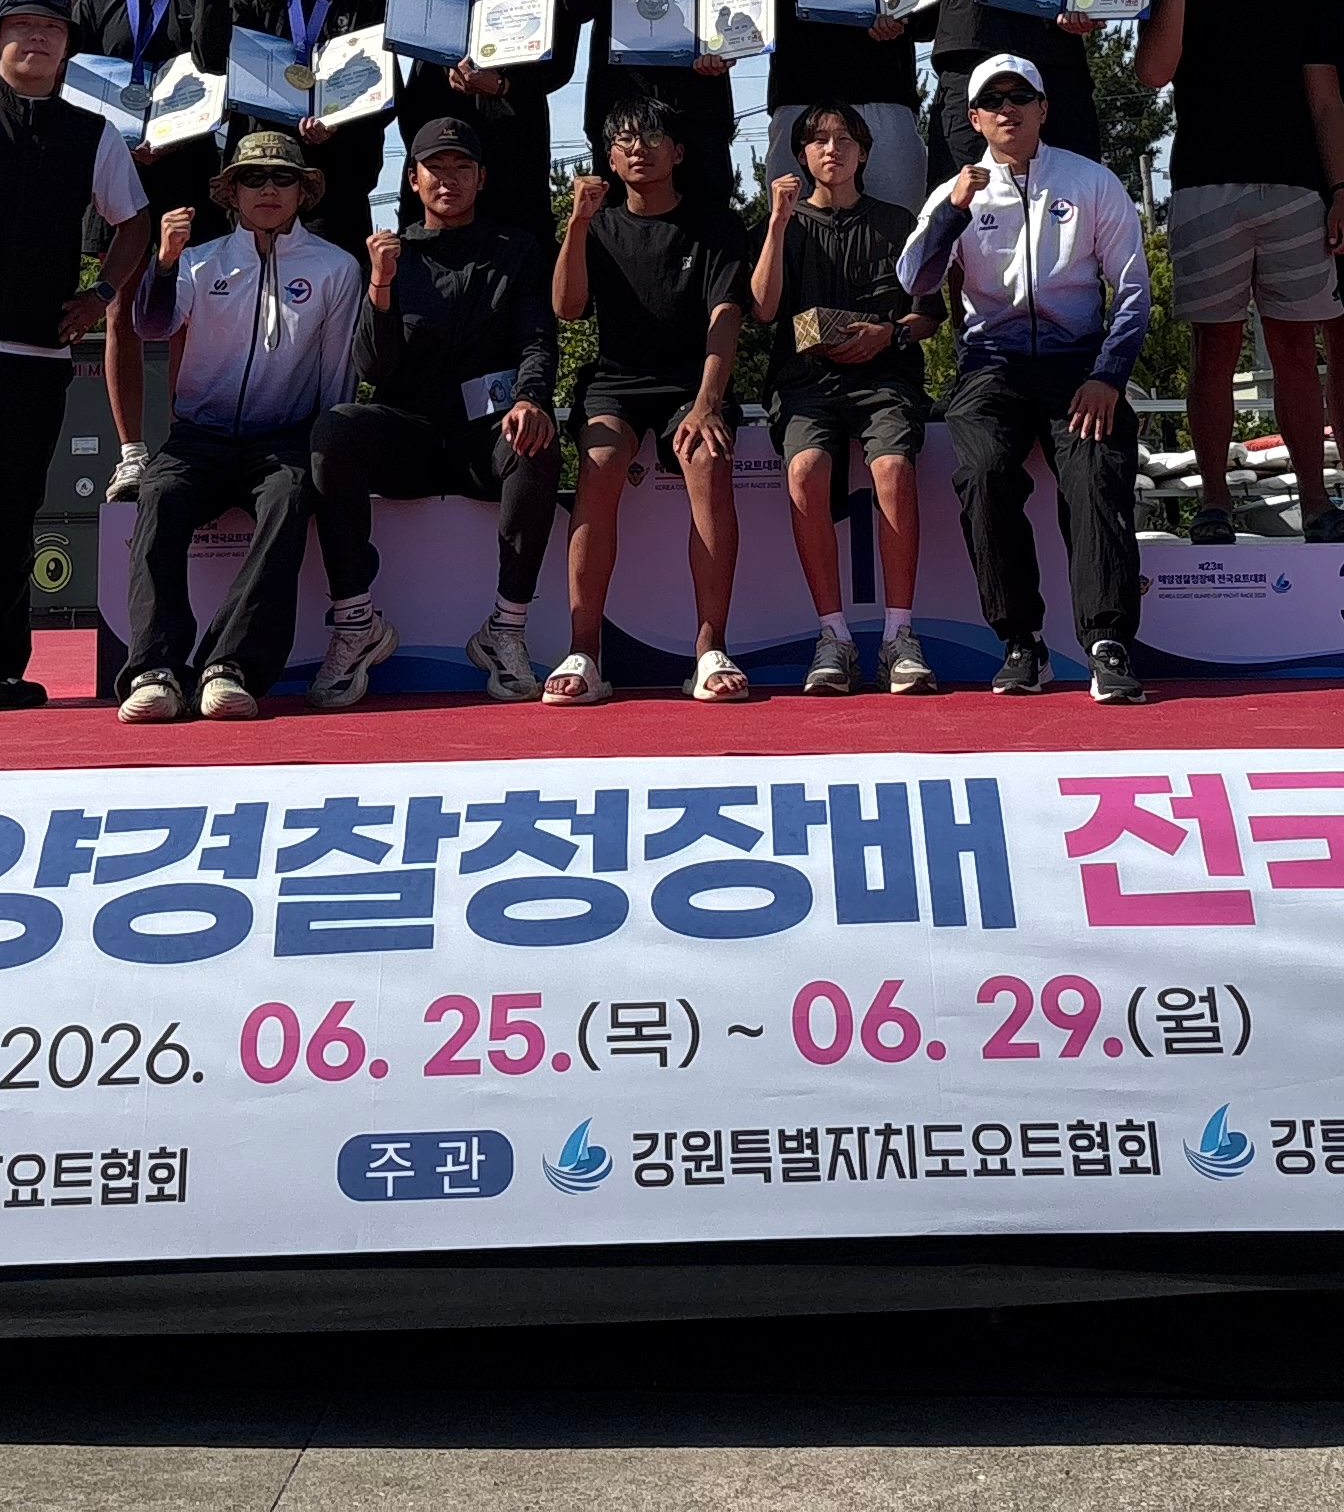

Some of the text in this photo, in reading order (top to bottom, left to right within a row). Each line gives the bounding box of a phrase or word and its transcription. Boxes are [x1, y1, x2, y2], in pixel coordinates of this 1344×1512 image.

[240, 1001, 388, 1084] 06.
[792, 980, 947, 1065] 06.
[632, 1118, 1162, 1188] 강원특별자치도요트협회
